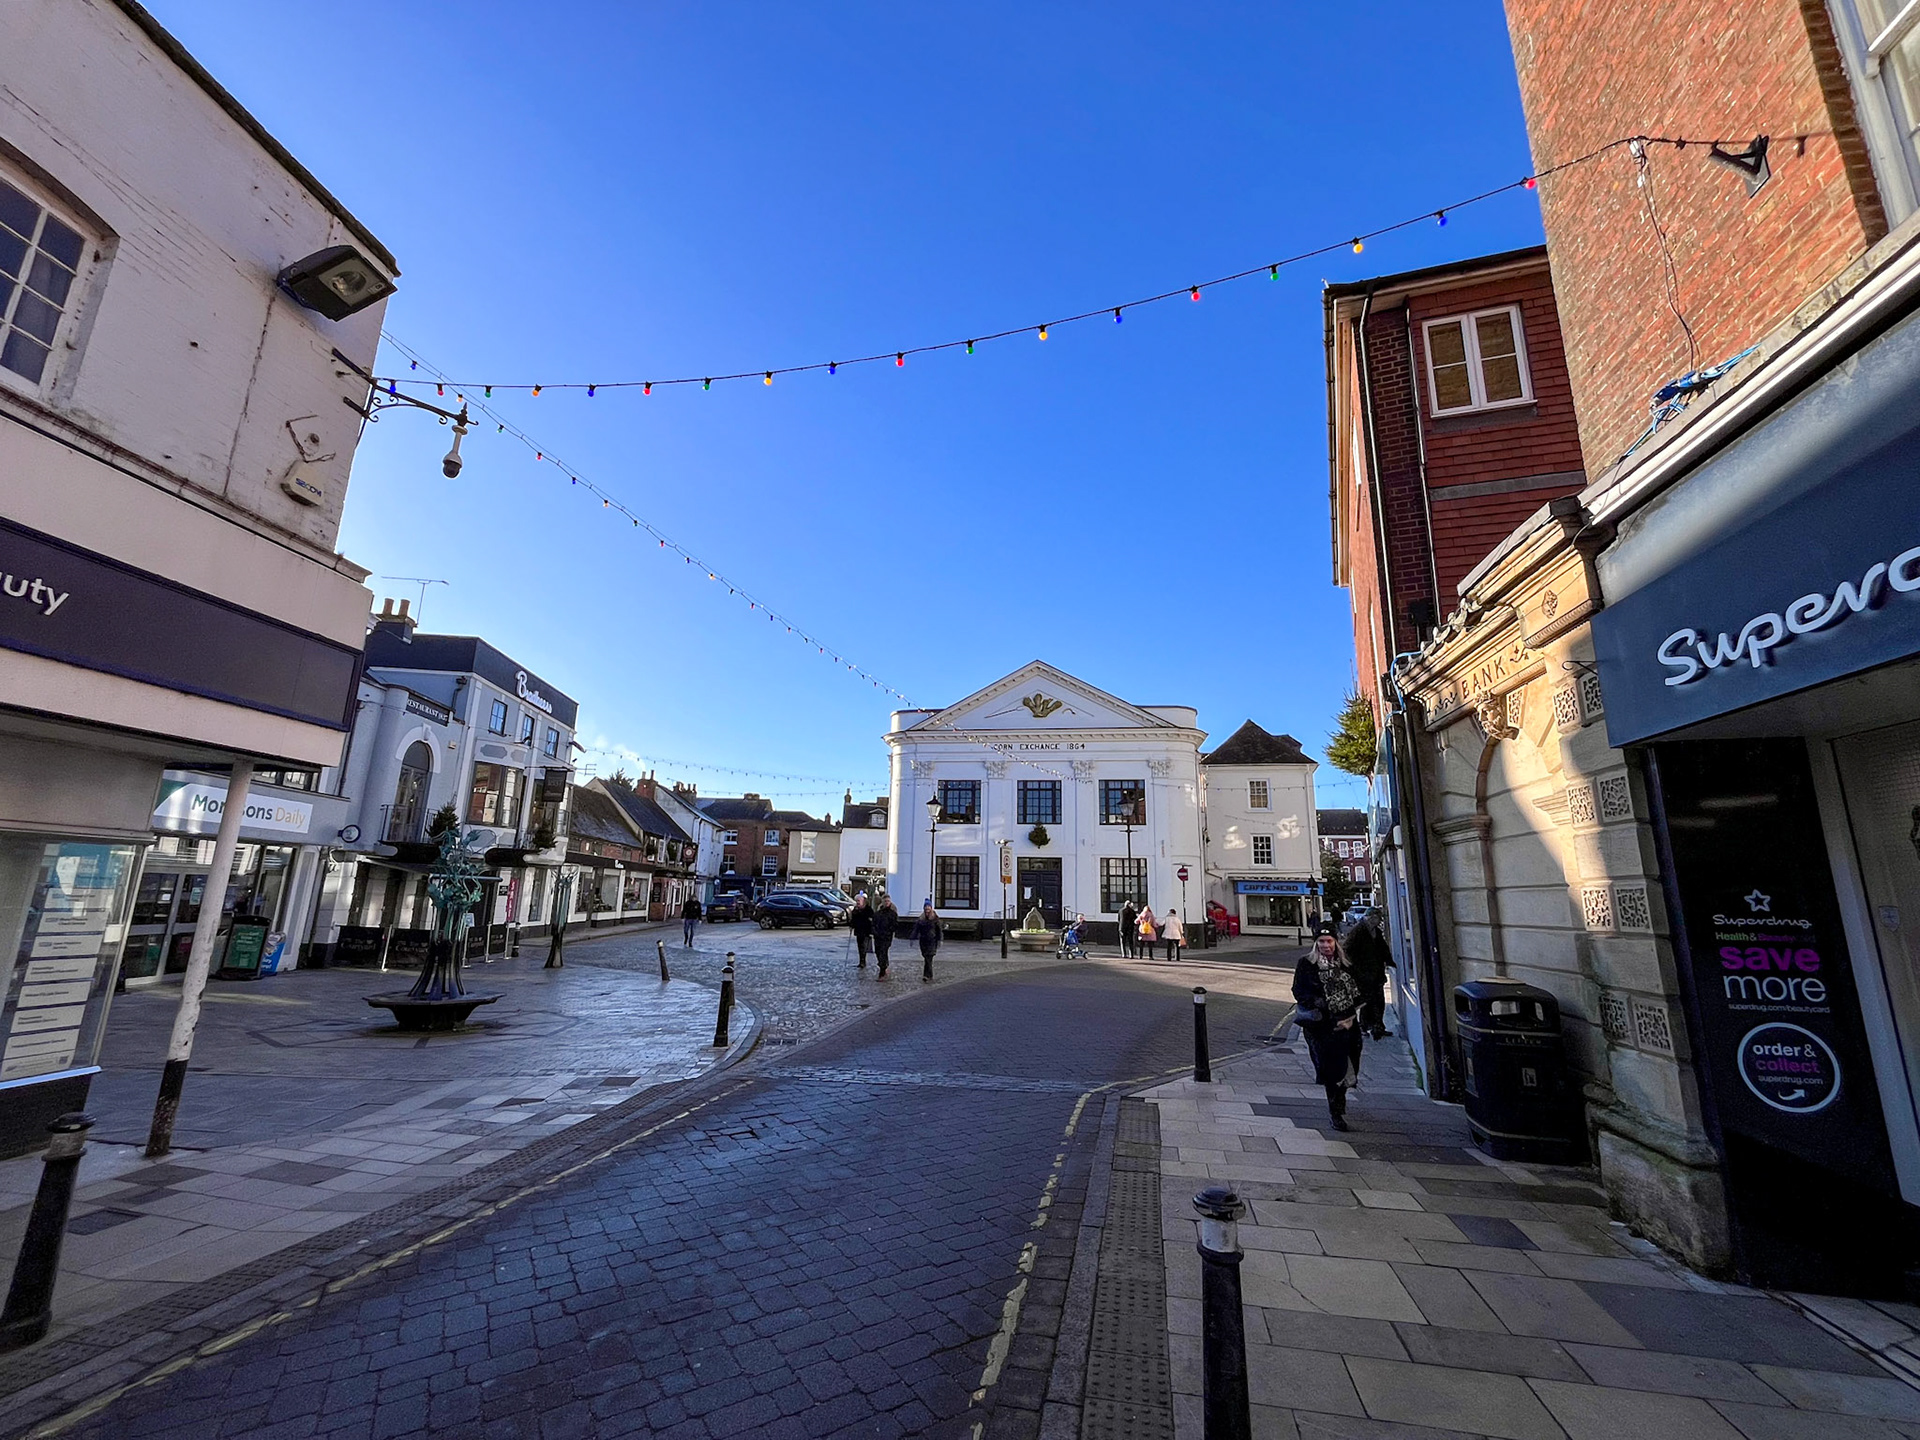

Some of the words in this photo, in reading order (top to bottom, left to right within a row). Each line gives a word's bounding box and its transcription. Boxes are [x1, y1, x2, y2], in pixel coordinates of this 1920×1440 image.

[0, 571, 70, 616] uty
[1461, 655, 1506, 700] BANK
[993, 743, 1013, 751] CORN
[192, 794, 273, 820] Morons
[275, 807, 307, 829] Daily
[1273, 884, 1299, 892] NERO
[1712, 914, 1812, 929] Superdrug
[1719, 946, 1820, 973] save
[1723, 975, 1827, 1003] more
[1752, 1043, 1801, 1057] order
[1803, 1043, 1817, 1058] &
[1755, 1058, 1820, 1074] collect
[1758, 1075, 1824, 1085] superdrug.com
